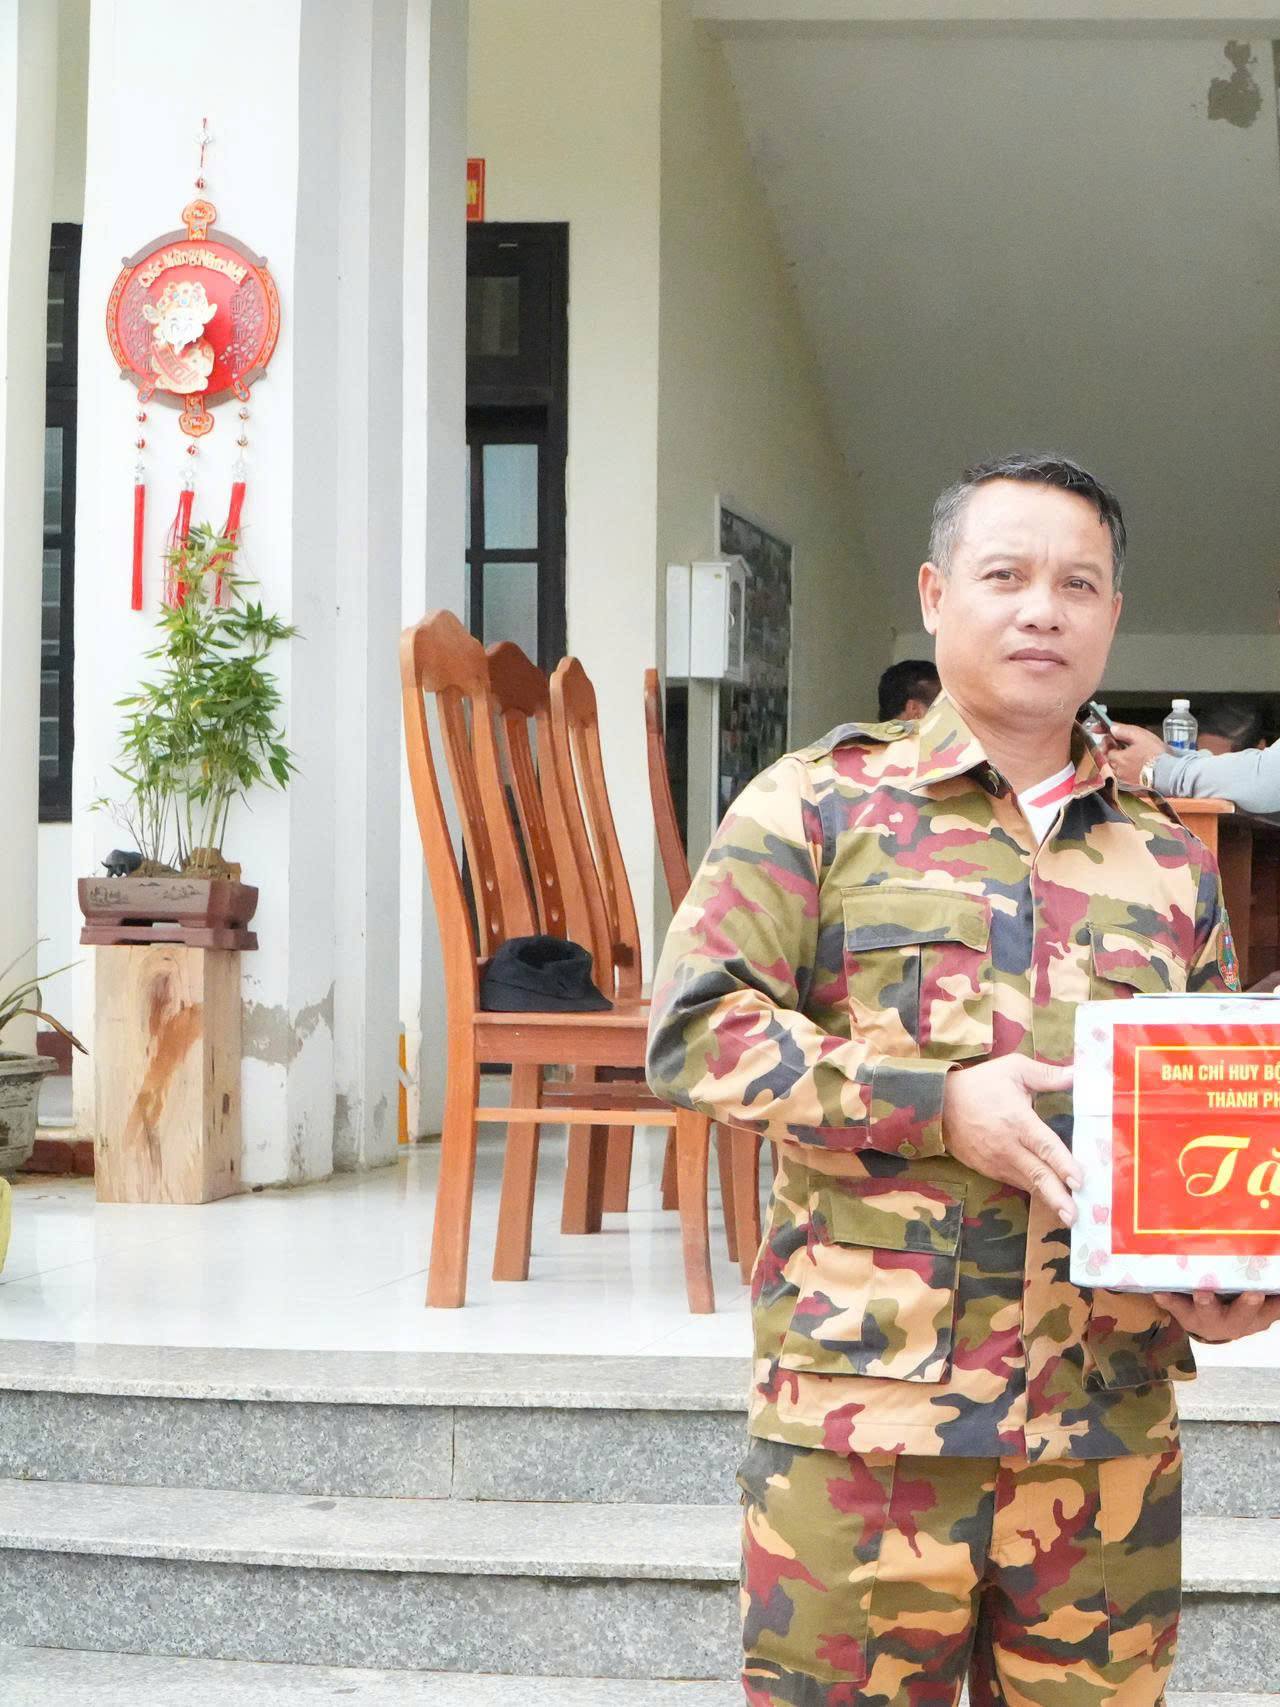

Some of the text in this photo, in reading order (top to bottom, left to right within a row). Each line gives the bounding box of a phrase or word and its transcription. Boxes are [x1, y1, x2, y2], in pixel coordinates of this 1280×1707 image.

[1161, 1064, 1194, 1081] BAN
[1229, 1064, 1260, 1081] HUY
[1207, 1088, 1258, 1108] THÀNH
